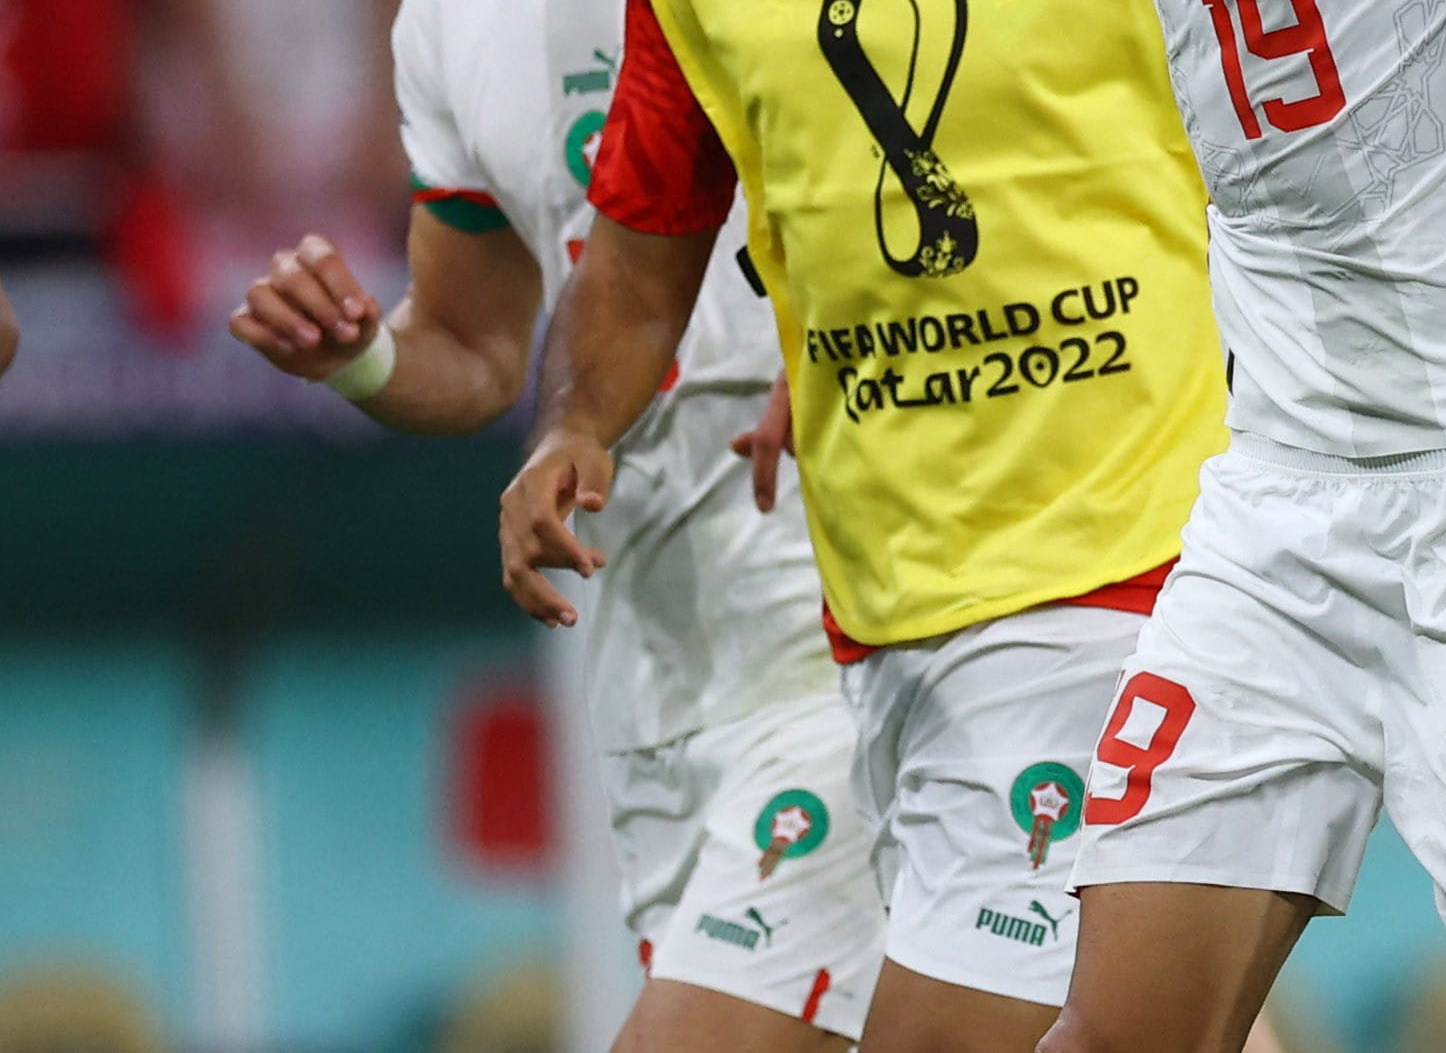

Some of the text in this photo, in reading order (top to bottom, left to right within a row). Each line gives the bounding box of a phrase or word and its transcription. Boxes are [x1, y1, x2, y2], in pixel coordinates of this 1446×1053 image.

[876, 302, 1040, 357] WORLD
[1051, 276, 1139, 326] CUP
[1079, 669, 1196, 829] 9
[976, 908, 1047, 947] PUMA
